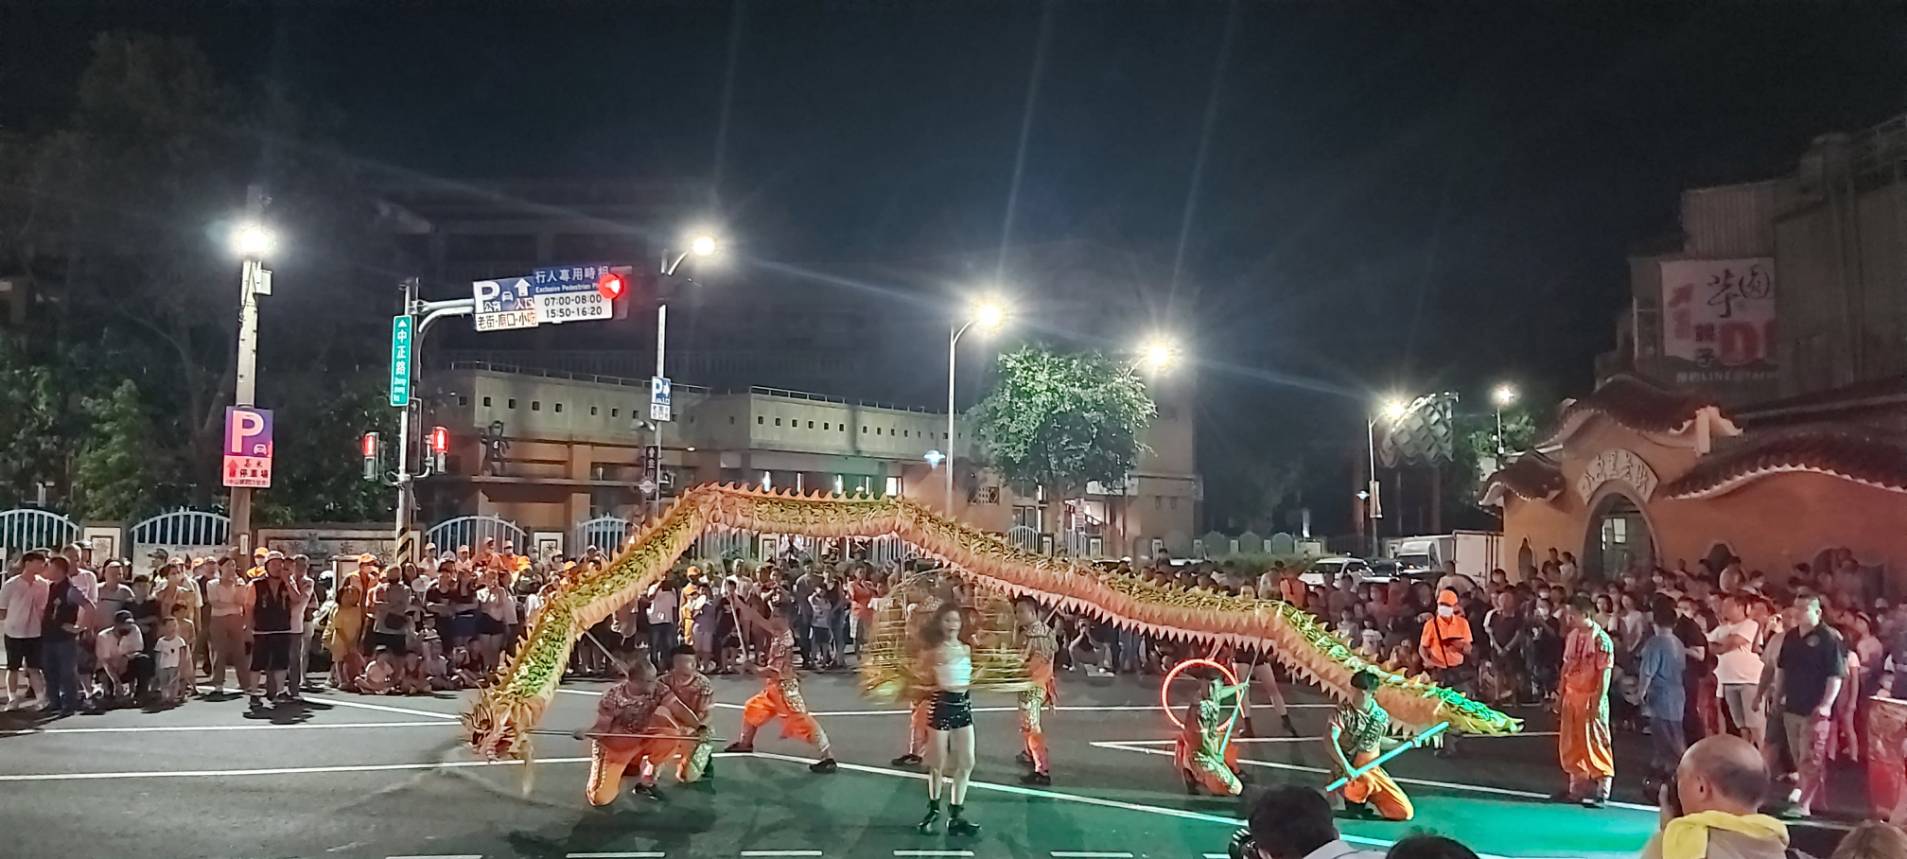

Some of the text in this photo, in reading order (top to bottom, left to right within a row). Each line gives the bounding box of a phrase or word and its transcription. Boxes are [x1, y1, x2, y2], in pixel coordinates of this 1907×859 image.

[473, 280, 500, 313] P
[544, 294, 602, 307] 07:00-08:00
[545, 306, 602, 318] 15:50-16:20
[396, 328, 408, 375] 中正路
[232, 410, 264, 453] P
